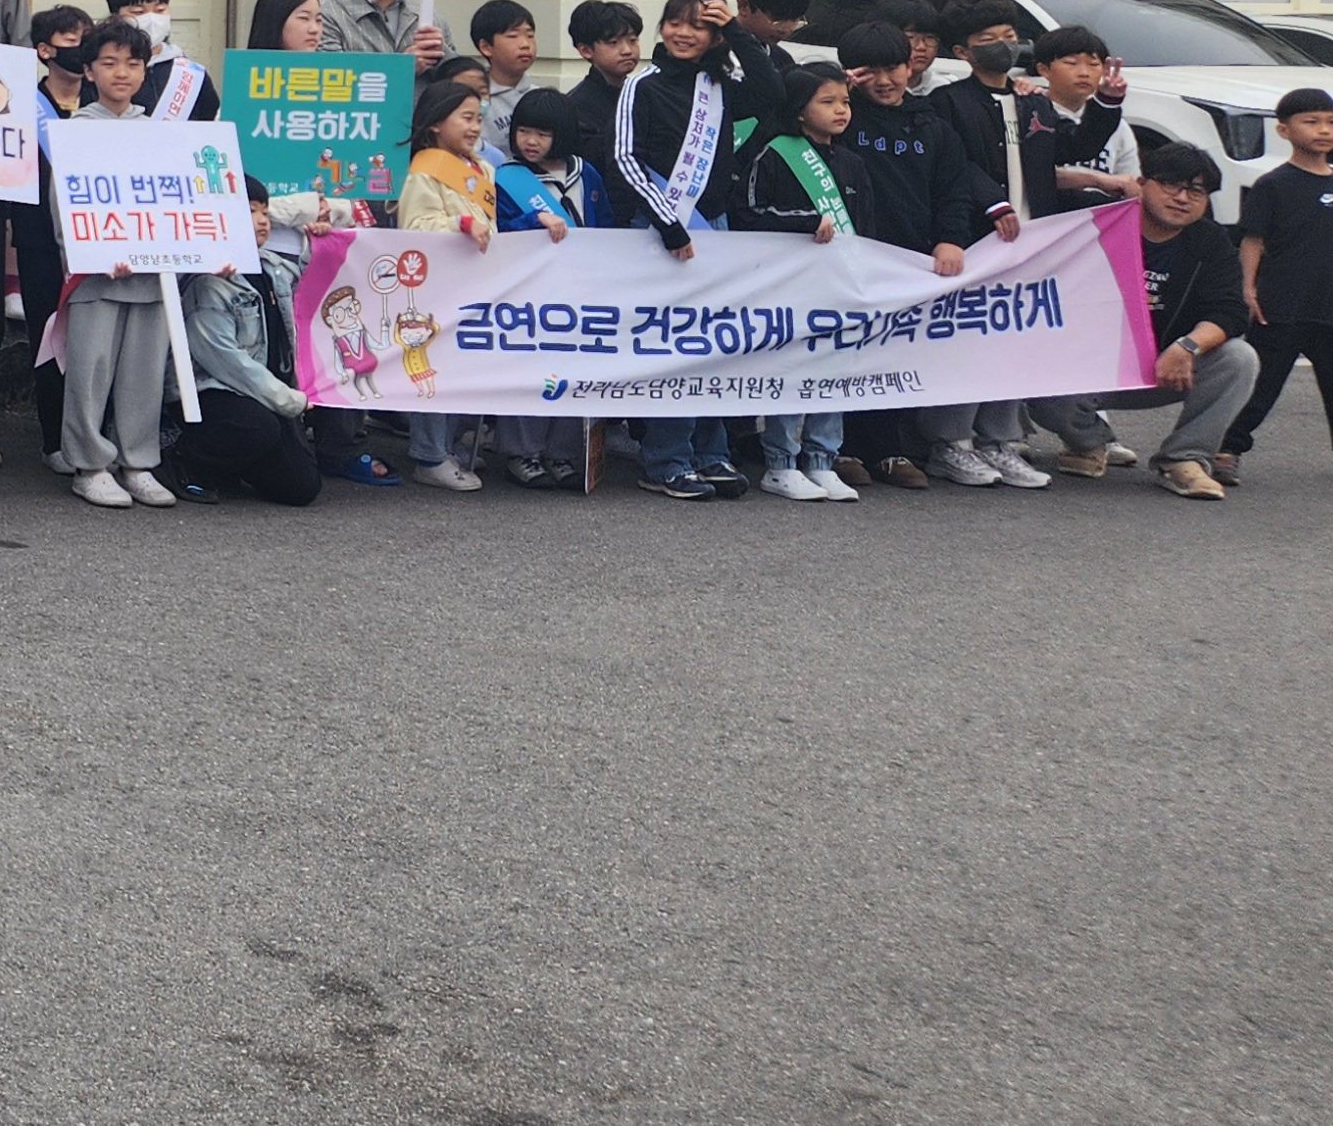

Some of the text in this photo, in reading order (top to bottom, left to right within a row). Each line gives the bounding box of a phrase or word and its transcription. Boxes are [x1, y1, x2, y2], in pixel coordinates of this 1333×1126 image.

[249, 66, 388, 103] 바른말을
[251, 110, 381, 142] 사용하자
[65, 174, 195, 205] 힘이 번쩍!
[263, 182, 299, 194] 등학교
[72, 210, 229, 241] 미소가 가득!
[456, 301, 620, 354] 금연으로
[630, 304, 794, 356] 건강하게
[927, 276, 1064, 339] 행복하게
[572, 370, 926, 400] 전라남도담양교육지원청 흡연예방캠페인
